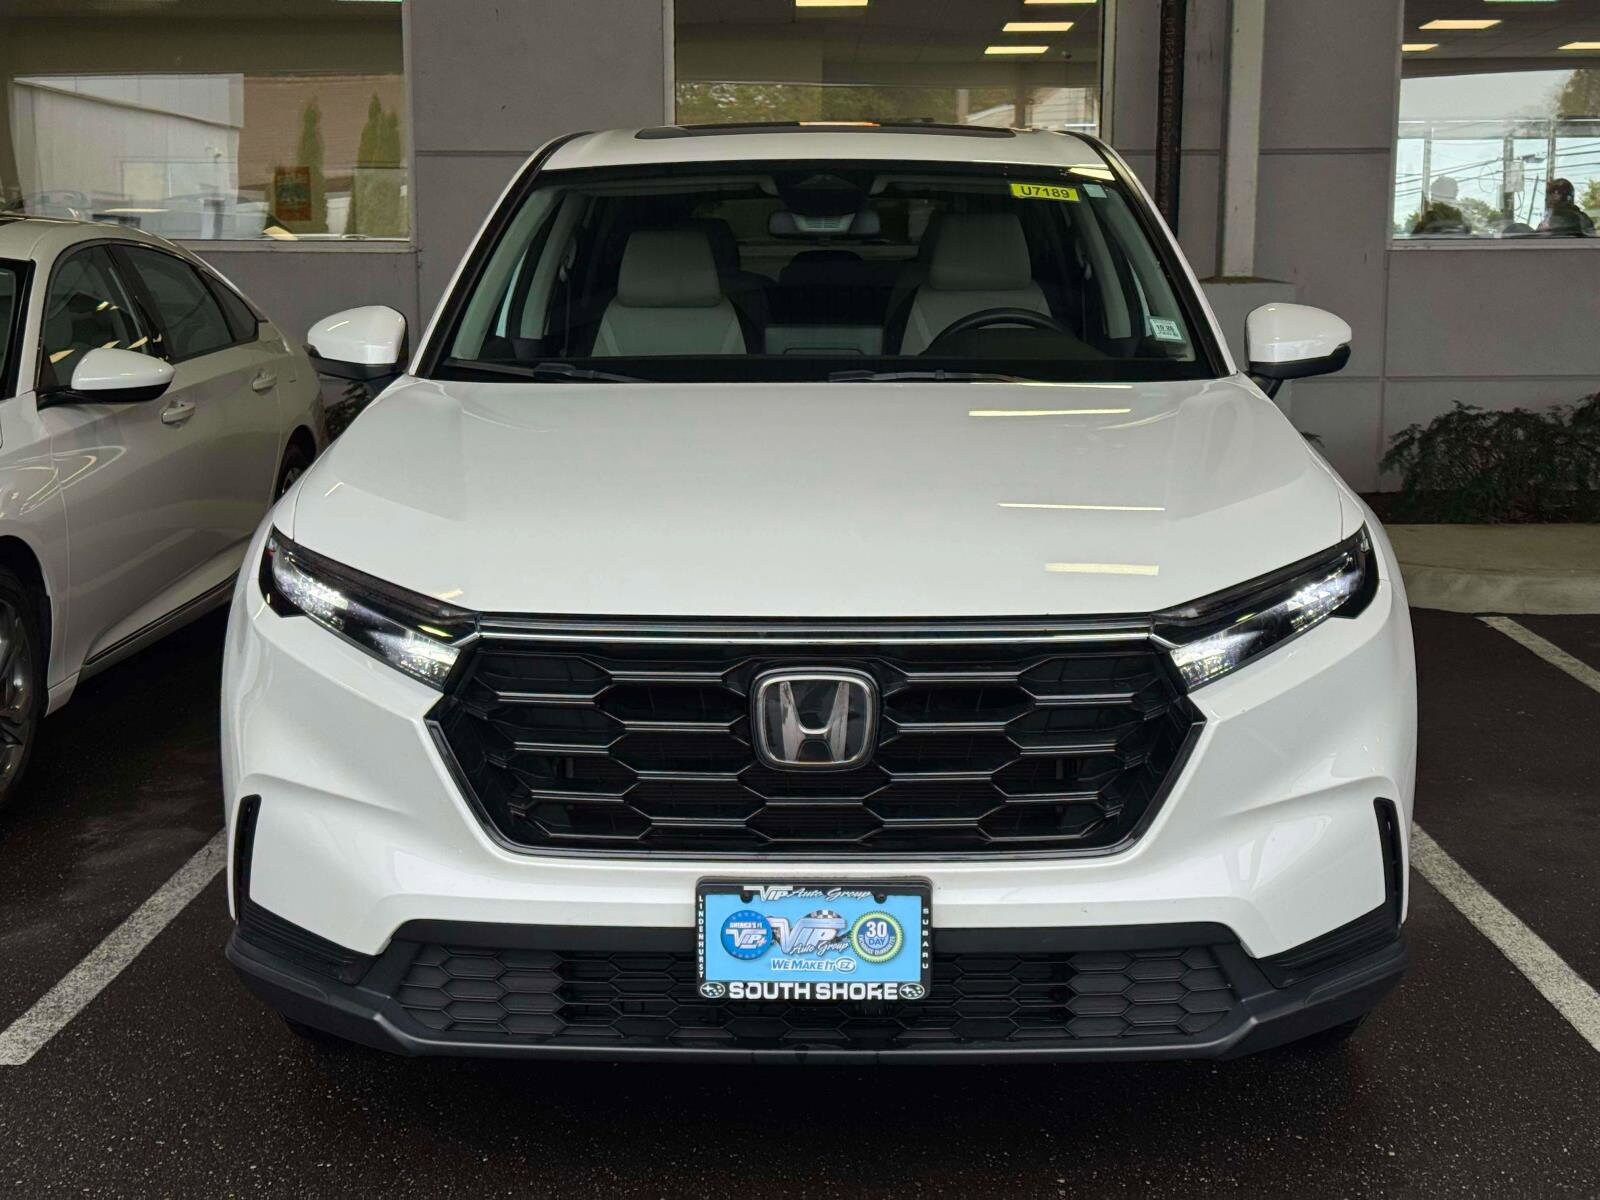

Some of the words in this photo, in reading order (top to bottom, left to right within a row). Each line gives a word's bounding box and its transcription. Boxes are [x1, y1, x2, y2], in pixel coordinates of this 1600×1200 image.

[1020, 185, 1070, 199] U7189
[744, 886, 793, 900] VIP
[788, 887, 824, 898] Auto
[825, 887, 874, 902] Group
[766, 917, 847, 954] VIP
[866, 921, 888, 938] 30
[790, 943, 815, 955] Auto
[815, 940, 849, 957] Group
[868, 938, 886, 946] DAY
[729, 982, 809, 1000] SOUTH
[815, 982, 898, 1000] SHORE
